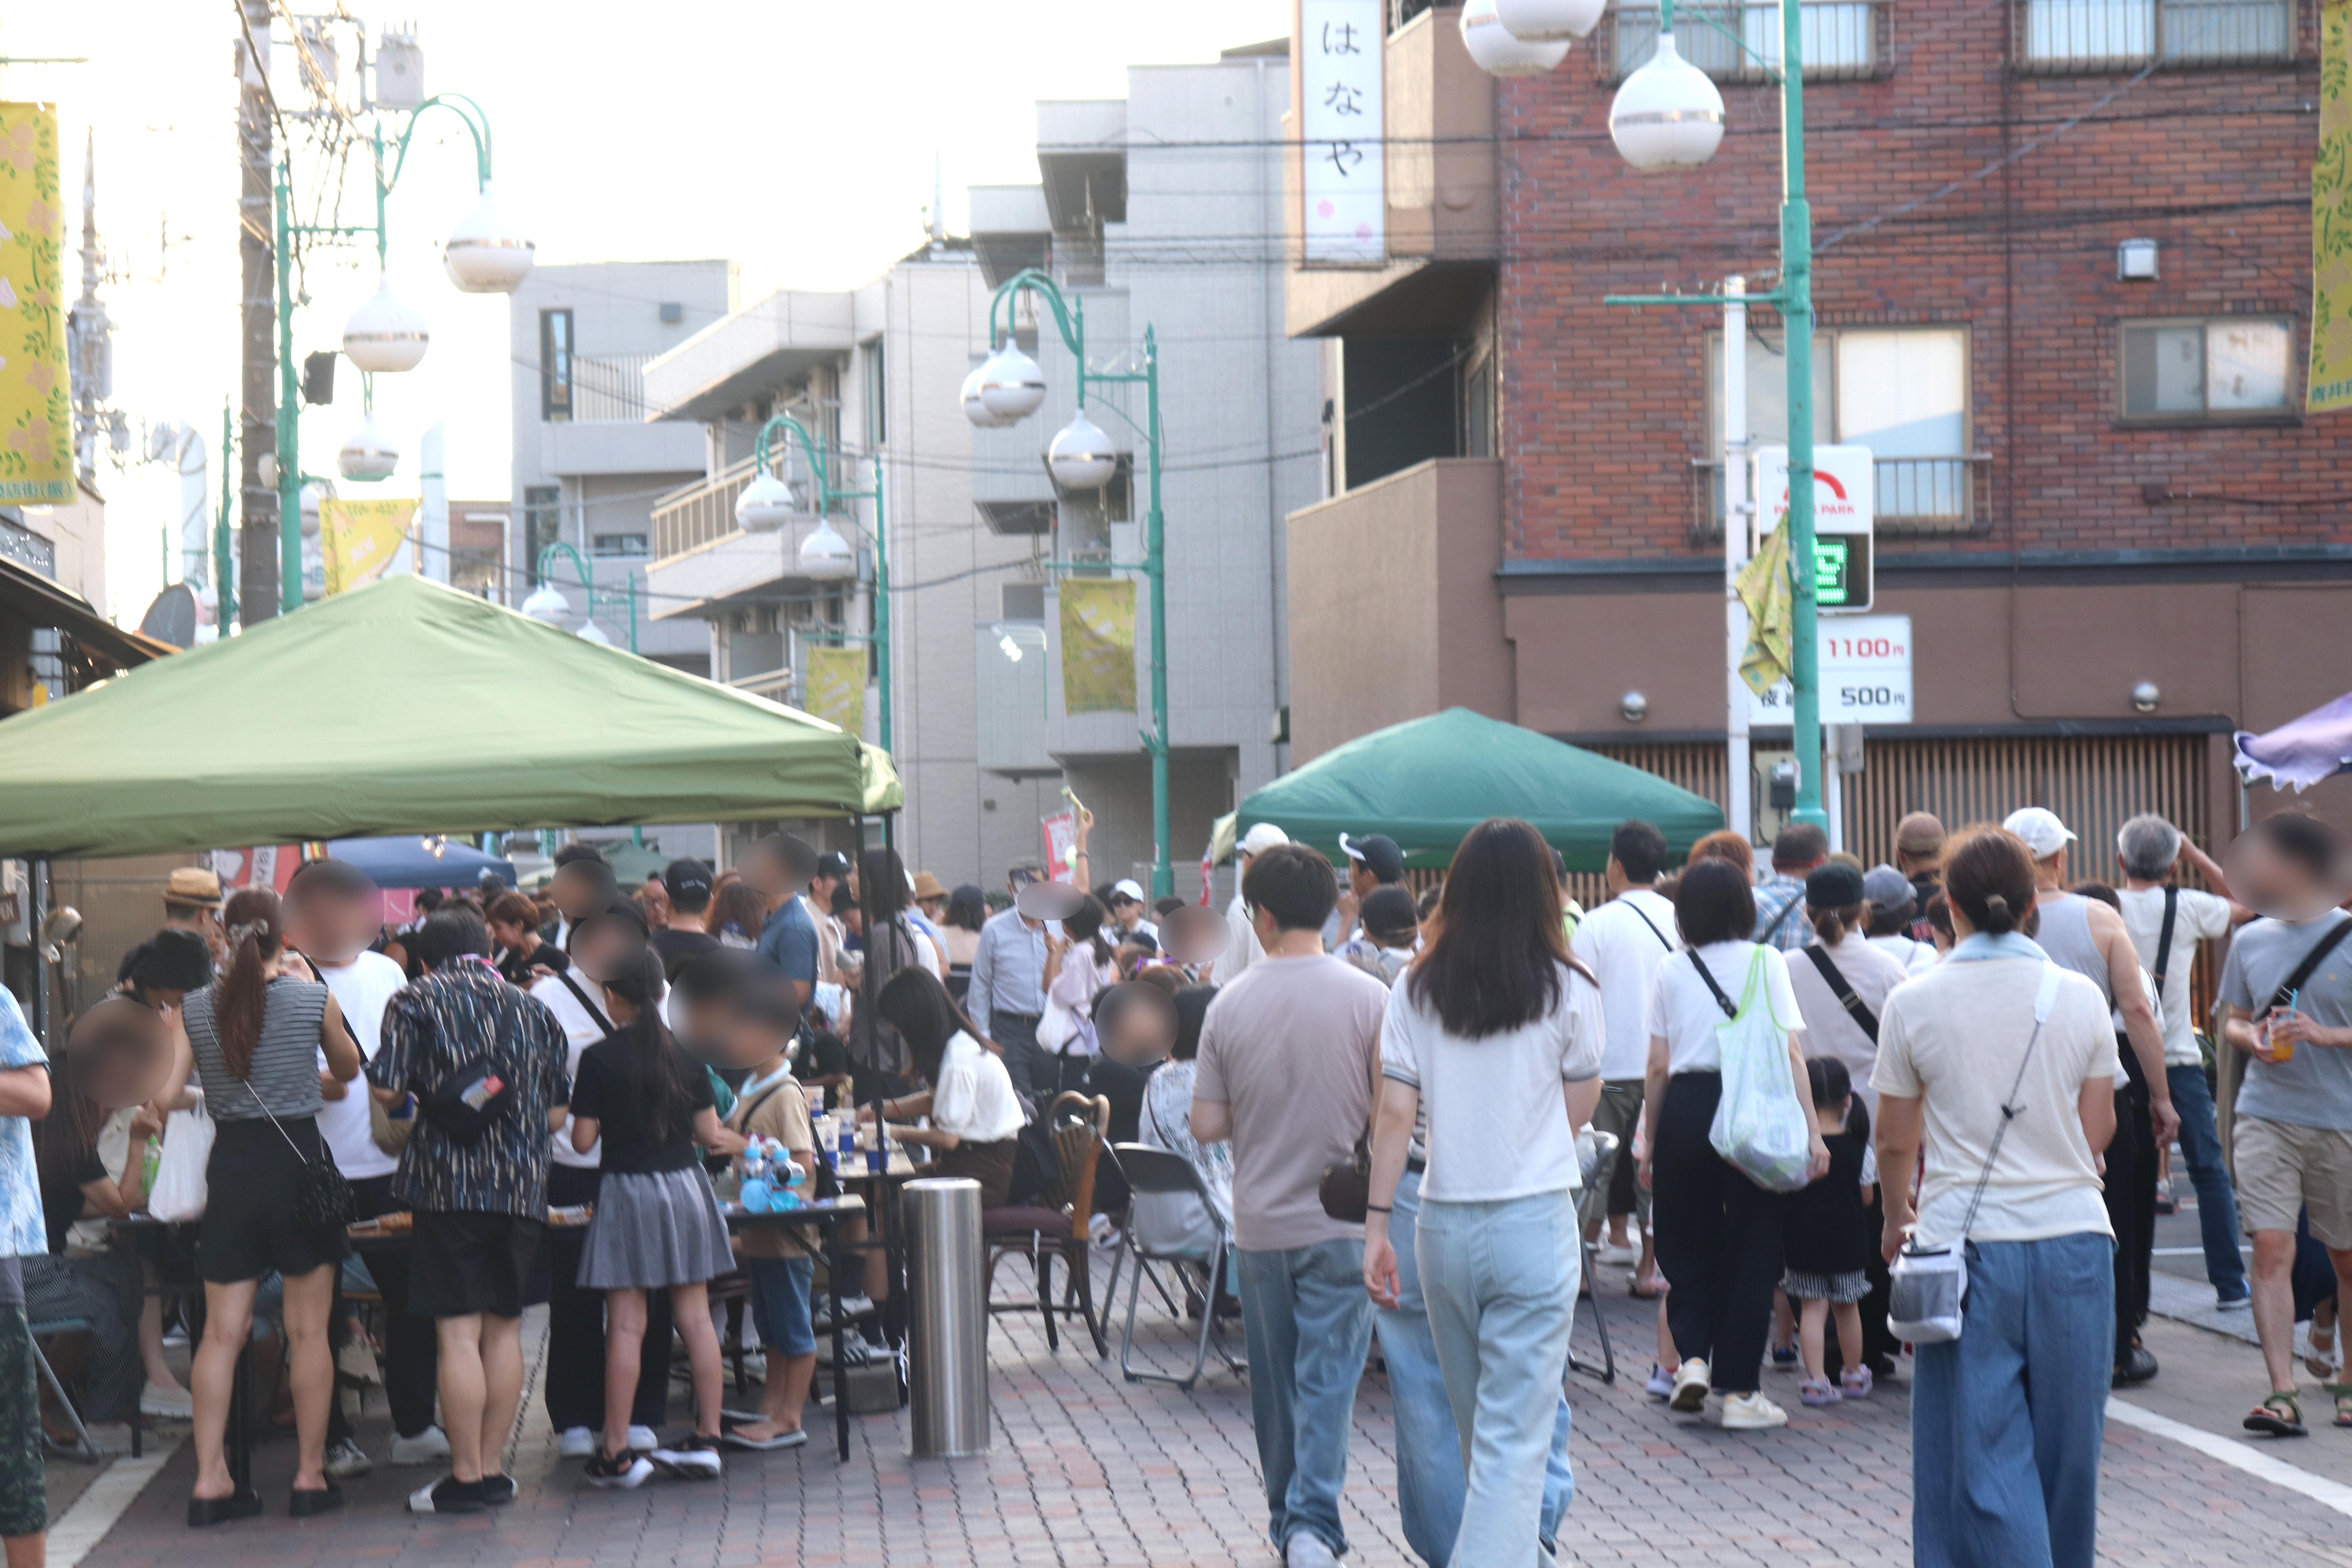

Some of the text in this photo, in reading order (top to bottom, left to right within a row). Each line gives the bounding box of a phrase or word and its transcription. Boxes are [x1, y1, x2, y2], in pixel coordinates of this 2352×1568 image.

[1323, 21, 1363, 178] はなや
[1822, 503, 1856, 515] PARK
